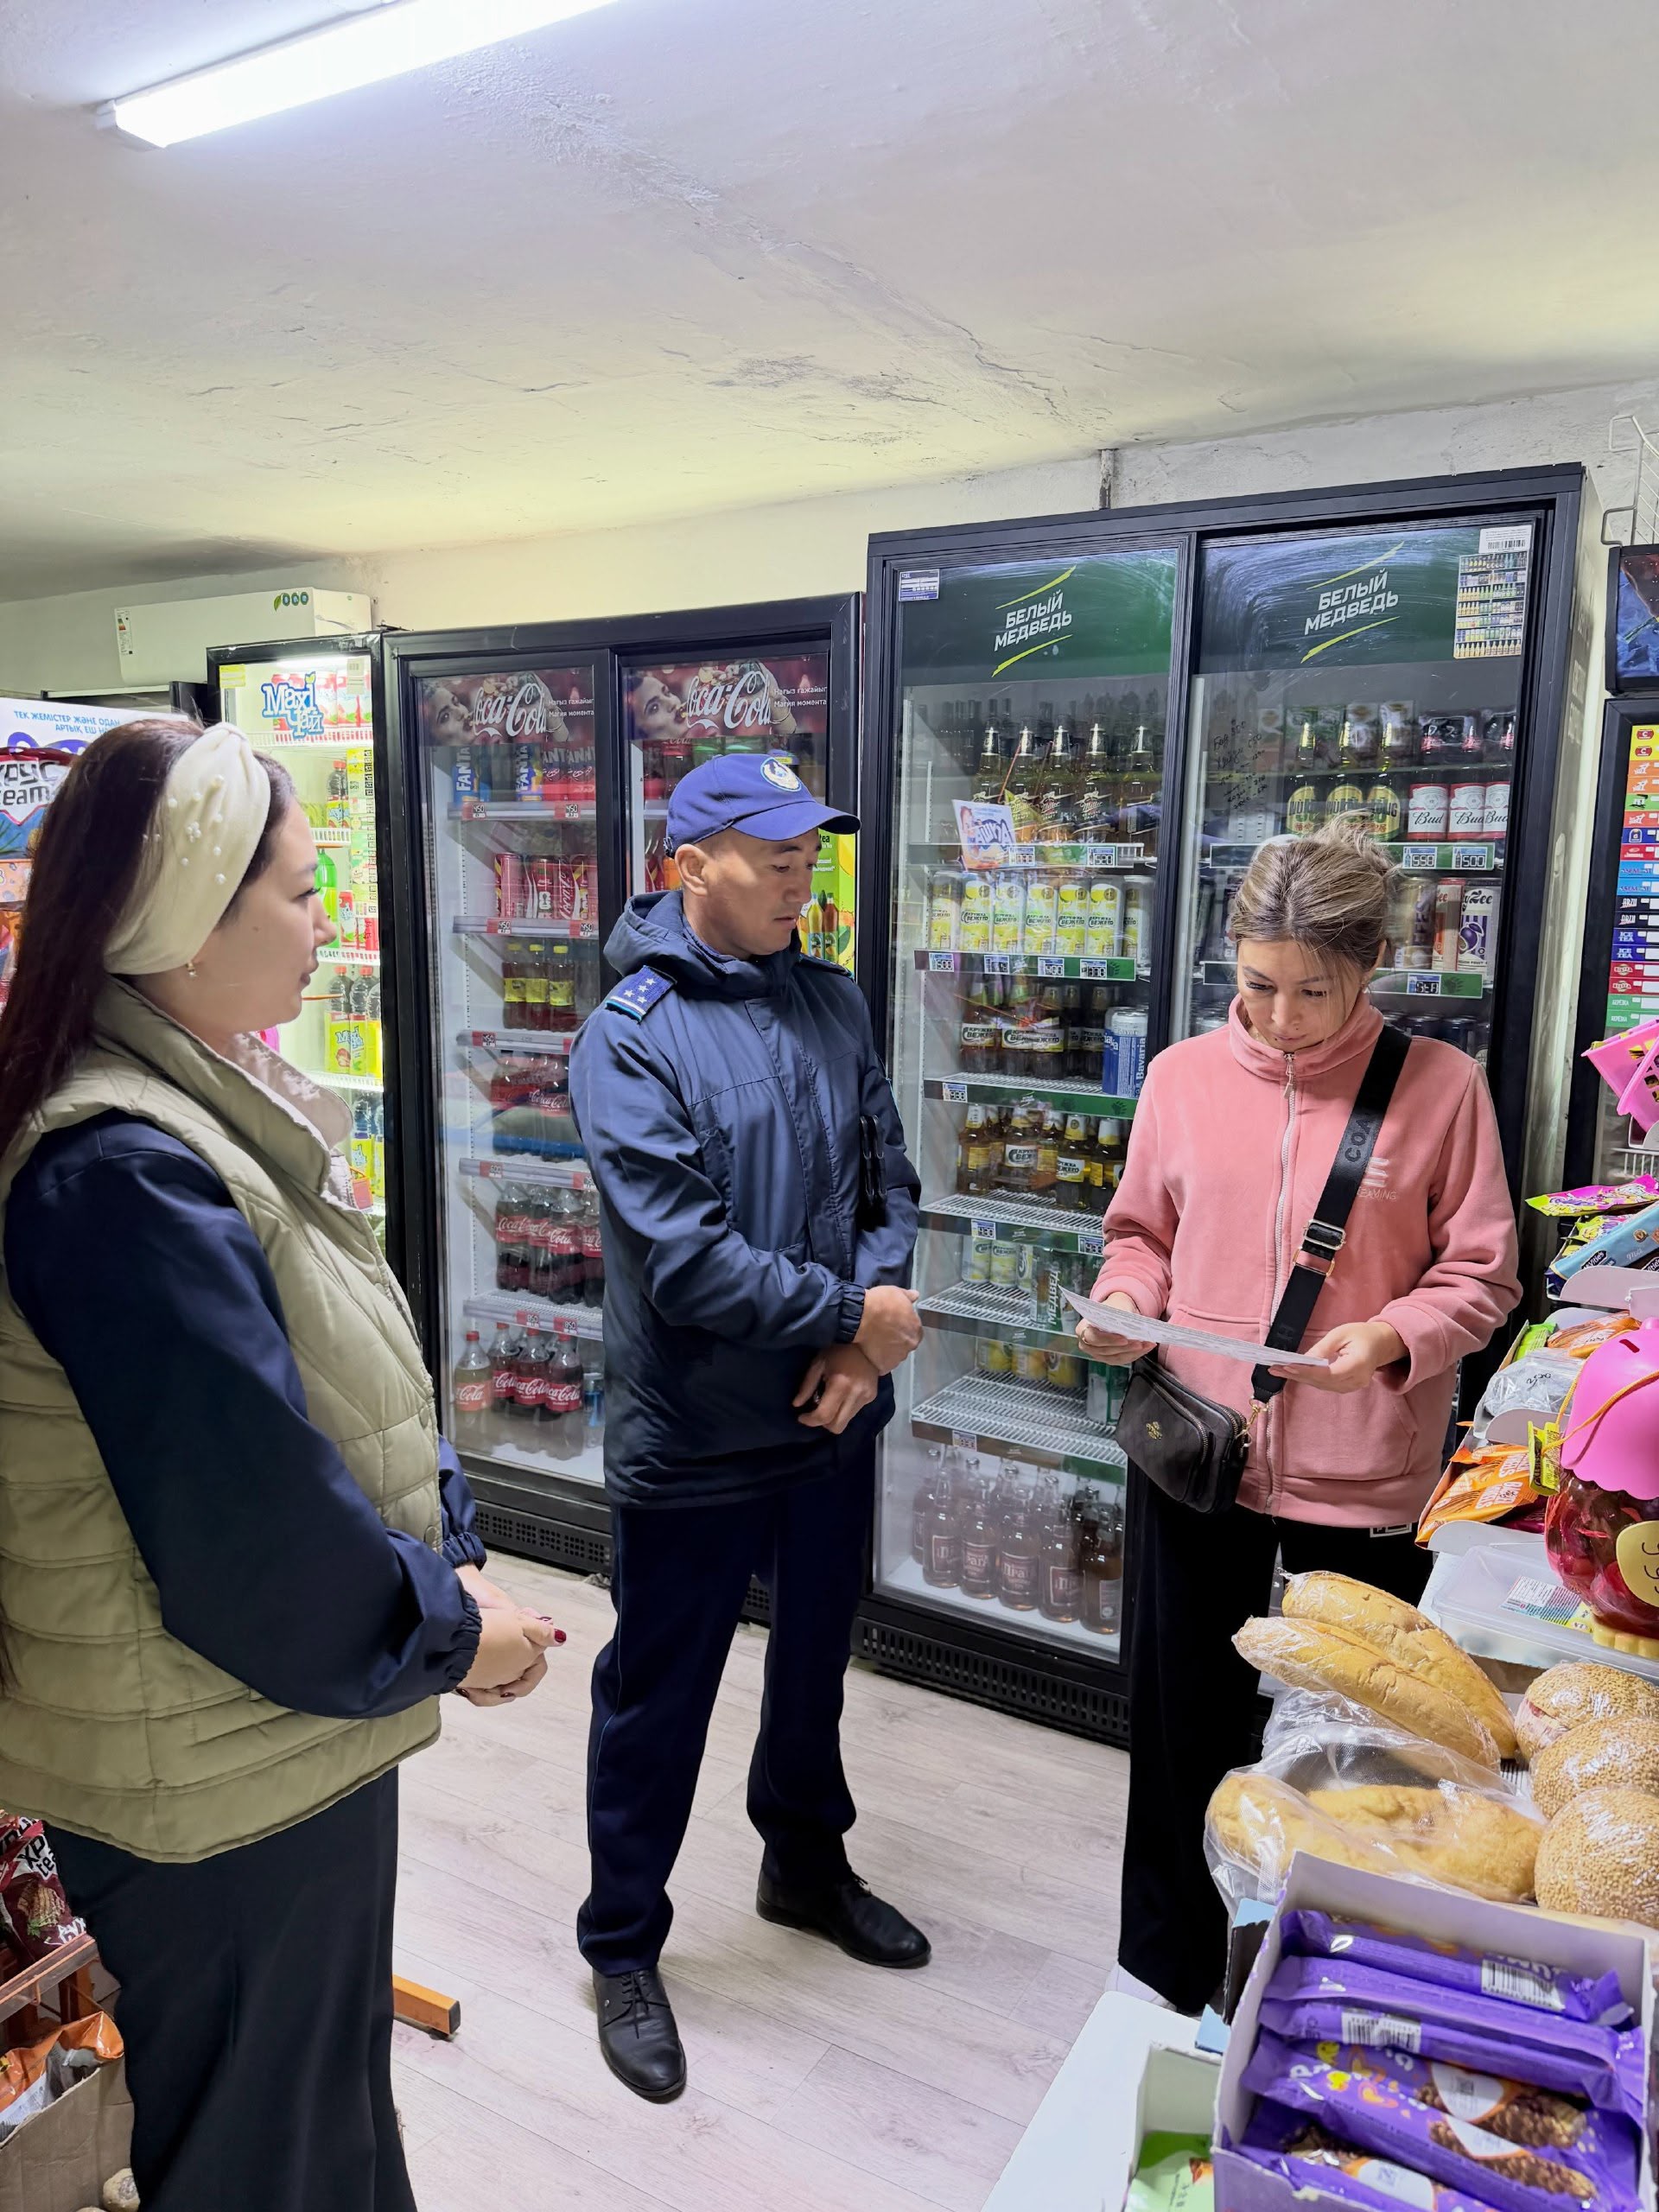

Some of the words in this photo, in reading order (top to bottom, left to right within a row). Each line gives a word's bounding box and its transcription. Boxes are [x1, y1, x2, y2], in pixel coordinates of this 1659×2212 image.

[1006, 589, 1064, 629] БЕЛЫЙ
[1318, 568, 1388, 611] БЕЛЫЙ
[995, 611, 1072, 652] МЕДВЕДЬ
[1304, 591, 1399, 636] МЕДВЕДЬ
[14, 710, 29, 719] ТЕК
[262, 672, 316, 717] Maxi
[456, 746, 472, 791] FANTA
[0, 785, 49, 805] eam
[1413, 811, 1445, 825] Bud
[1462, 855, 1485, 867] 500
[1135, 1037, 1147, 1081] Bavaria
